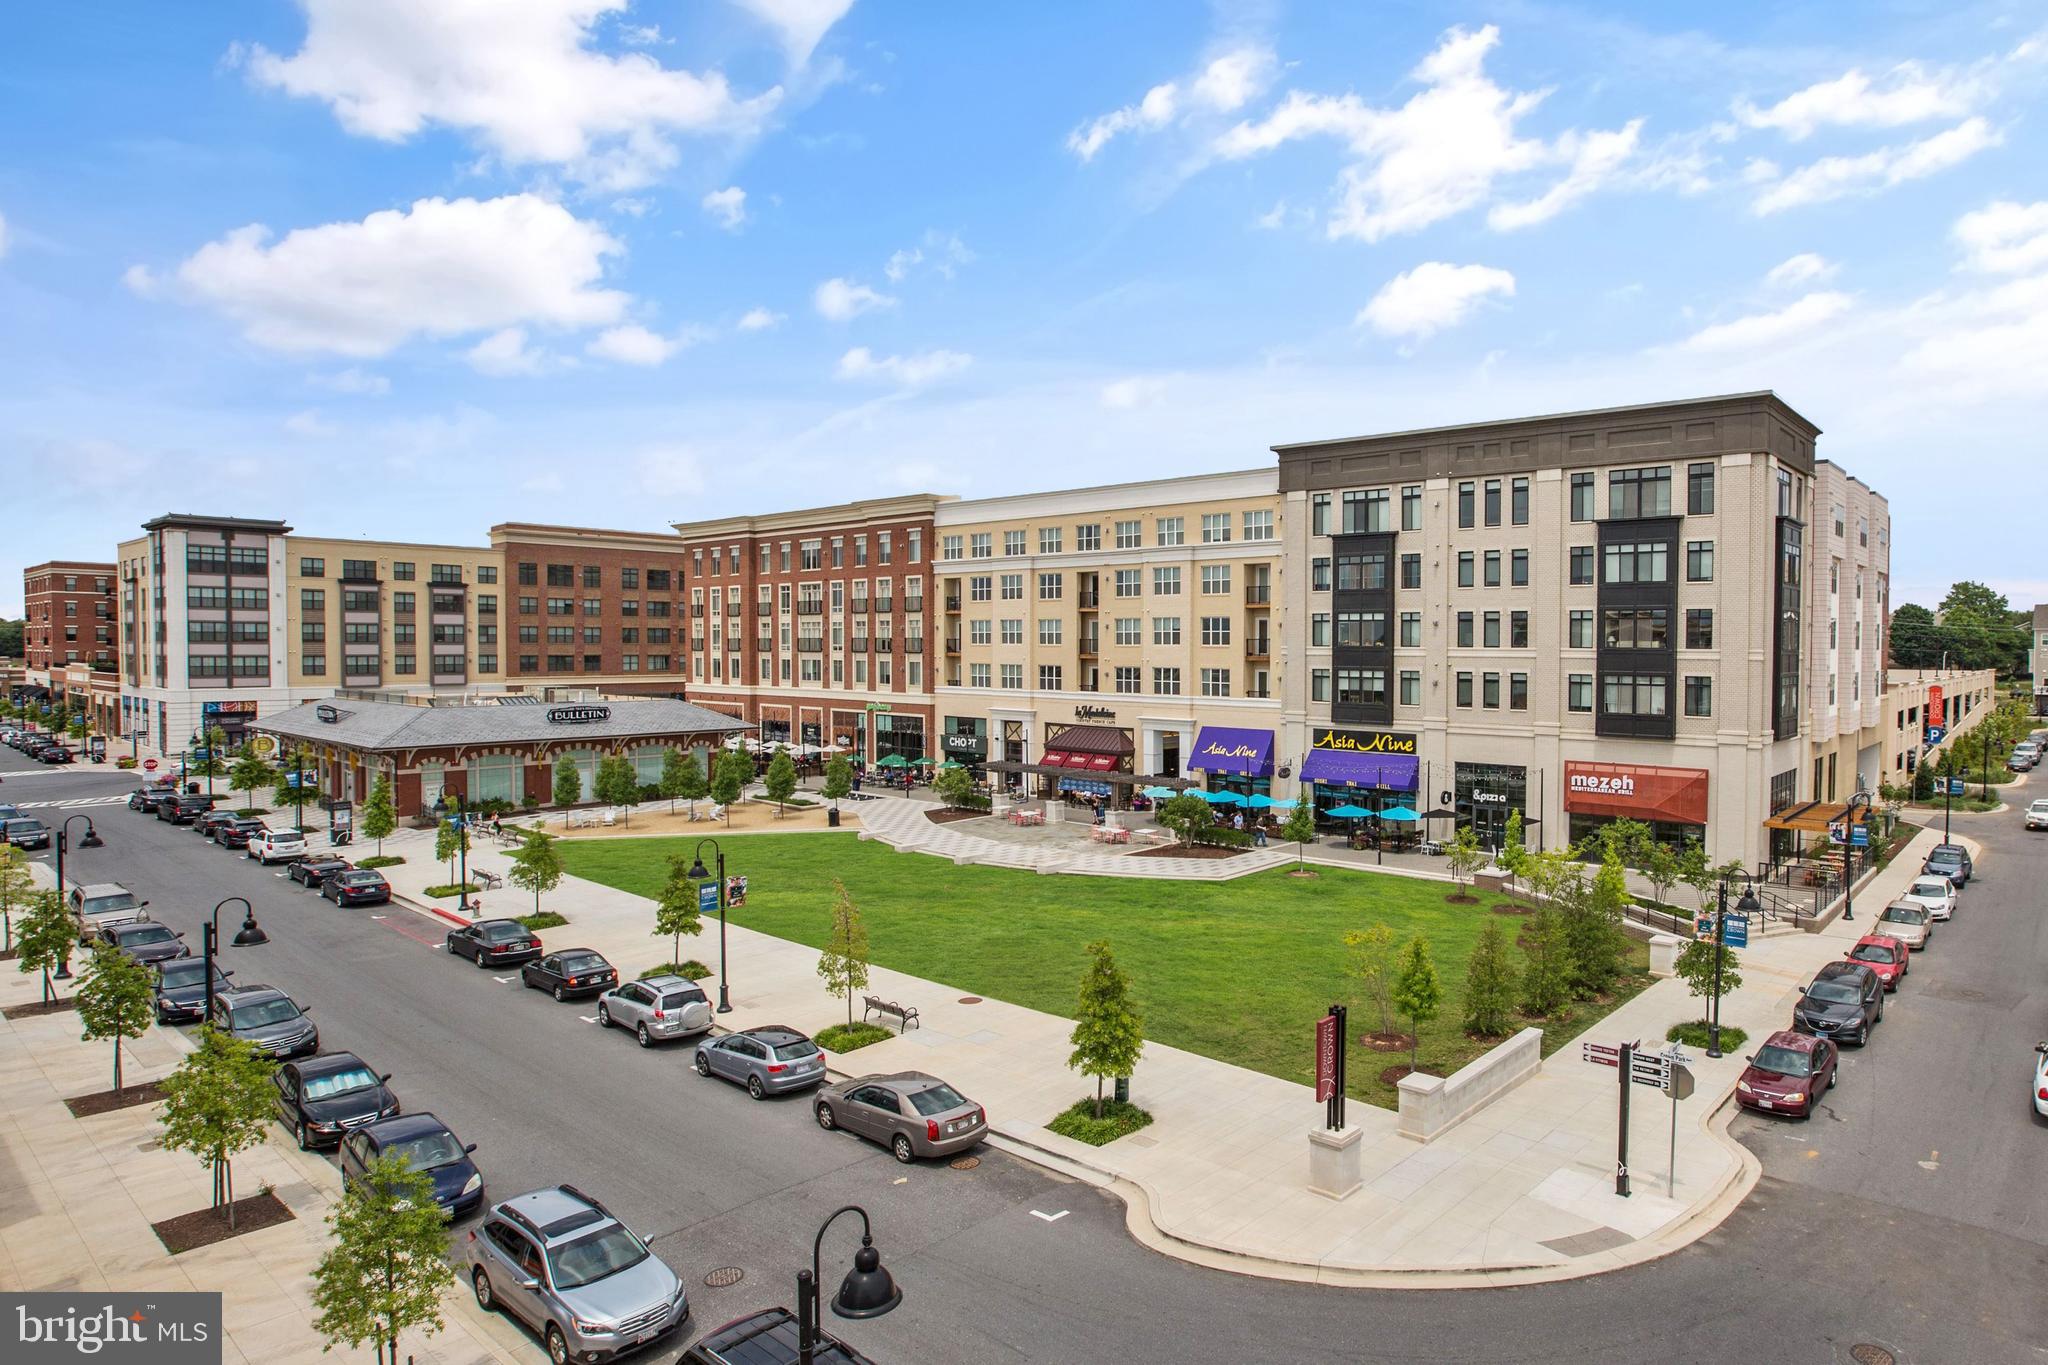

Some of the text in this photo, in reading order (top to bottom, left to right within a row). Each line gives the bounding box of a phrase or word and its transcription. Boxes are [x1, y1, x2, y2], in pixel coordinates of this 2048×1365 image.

[555, 710, 604, 720] BULLETIN
[1313, 730, 1414, 752] Asia Nine
[1931, 730, 1939, 741] P
[1202, 742, 1258, 757] Asia Nine
[1571, 774, 1634, 790] mezeh
[1473, 788, 1506, 803] &pizza
[1571, 786, 1616, 794] MEDITERRANEAN
